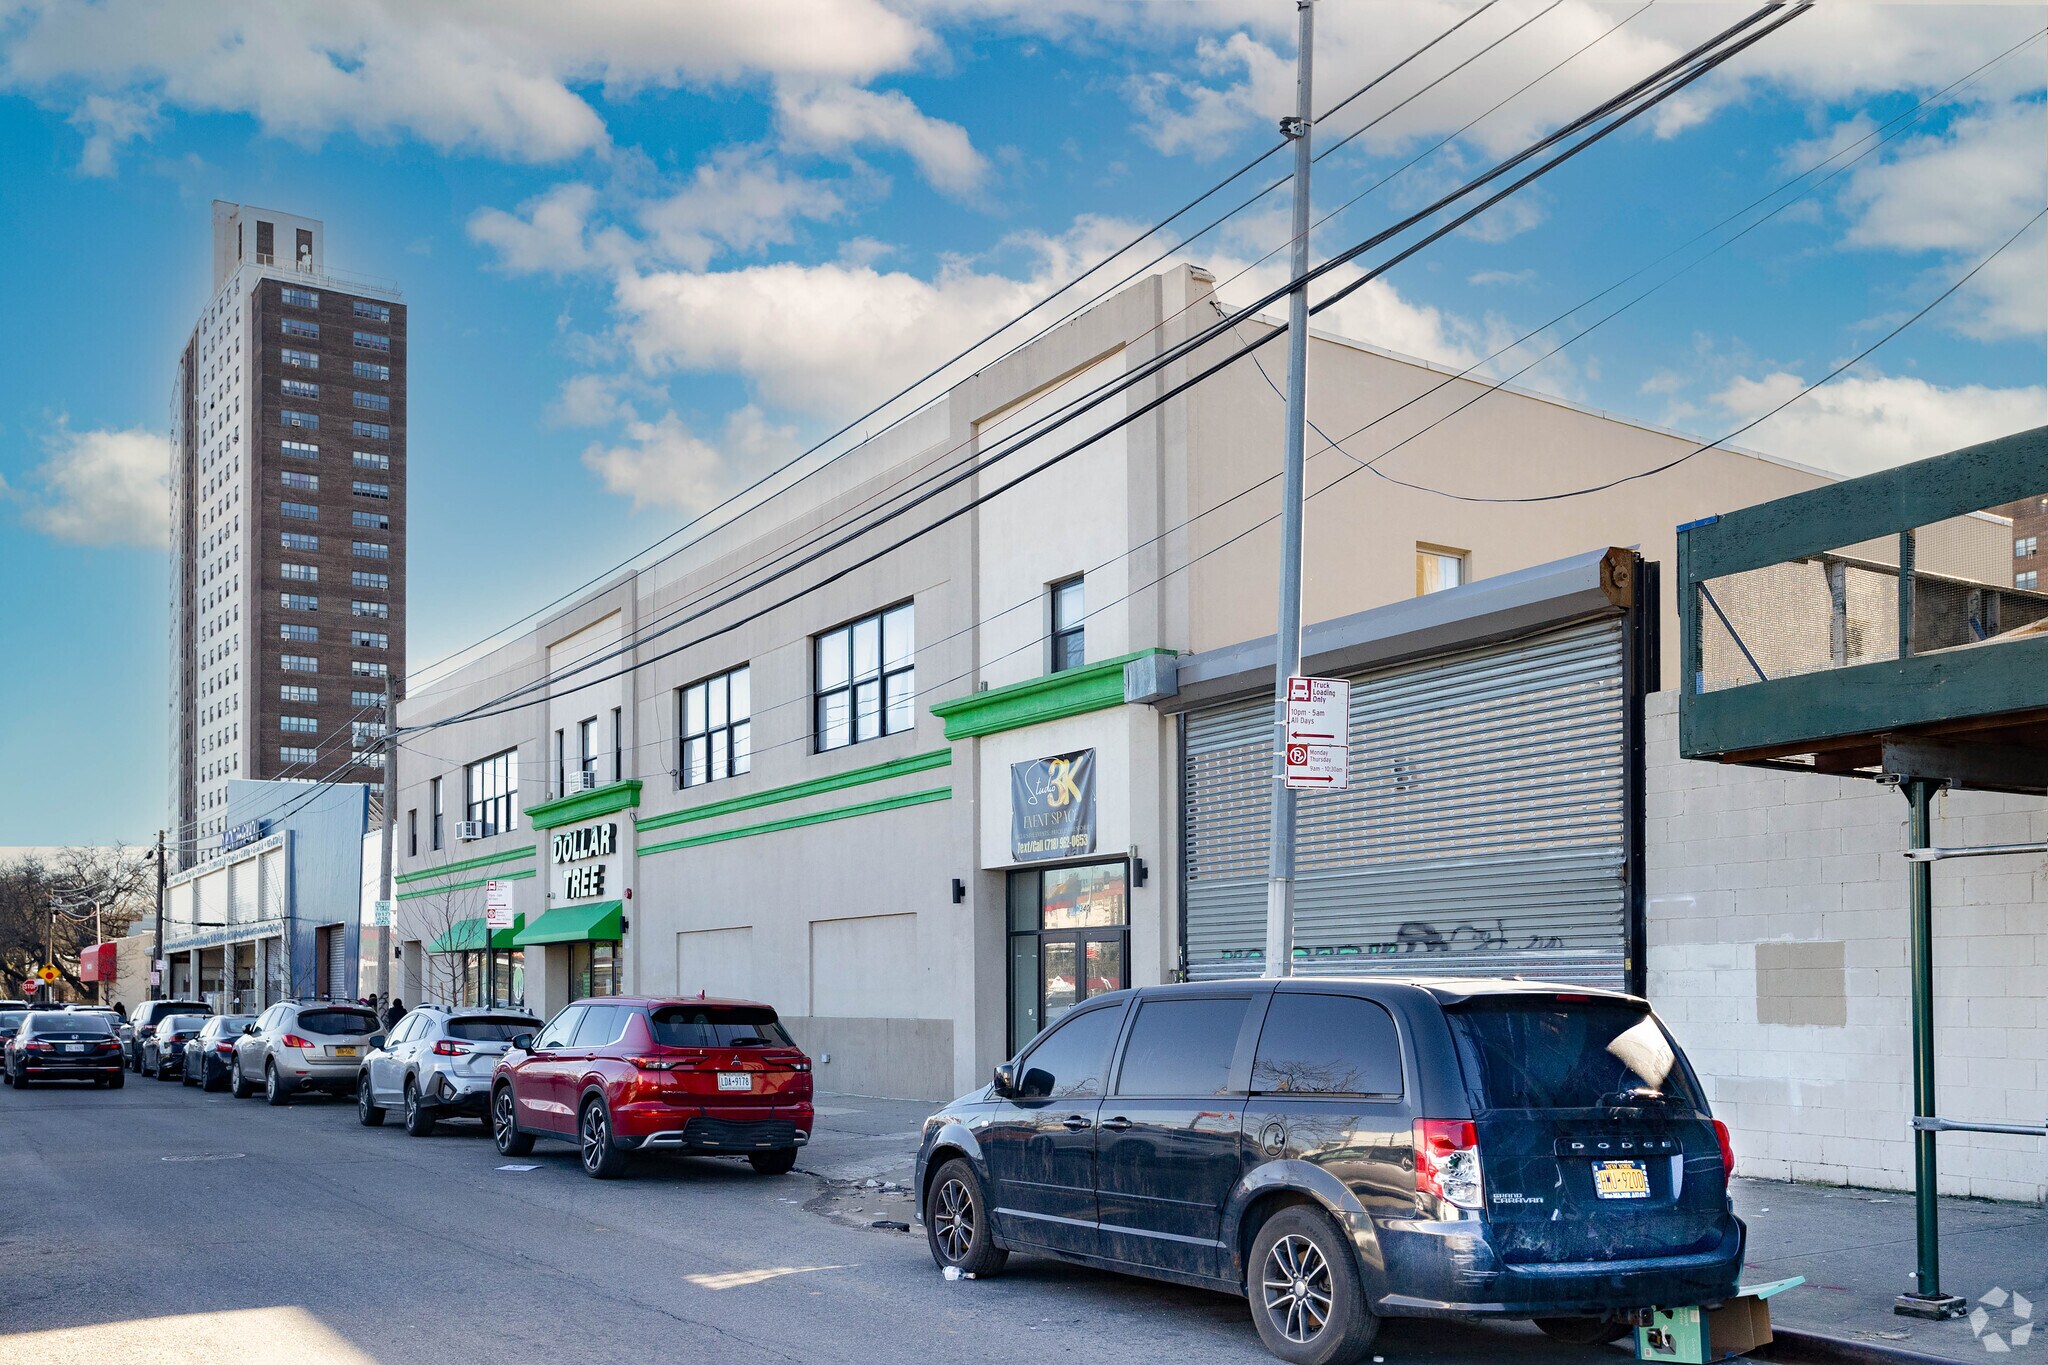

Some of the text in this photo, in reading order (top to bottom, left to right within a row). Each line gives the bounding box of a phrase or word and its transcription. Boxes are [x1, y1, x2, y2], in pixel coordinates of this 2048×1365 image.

[1313, 681, 1330, 689] Truck
[1313, 688, 1336, 697] Loading
[1291, 708, 1307, 717] 10pm
[1312, 709, 1325, 717] 5am
[1301, 717, 1315, 725] Days
[1025, 756, 1083, 807] Studio 3K
[1024, 812, 1050, 829] EVENT
[552, 823, 616, 864] DOLLAR
[563, 865, 605, 899] TREE
[1571, 1141, 1671, 1150] DODGE
